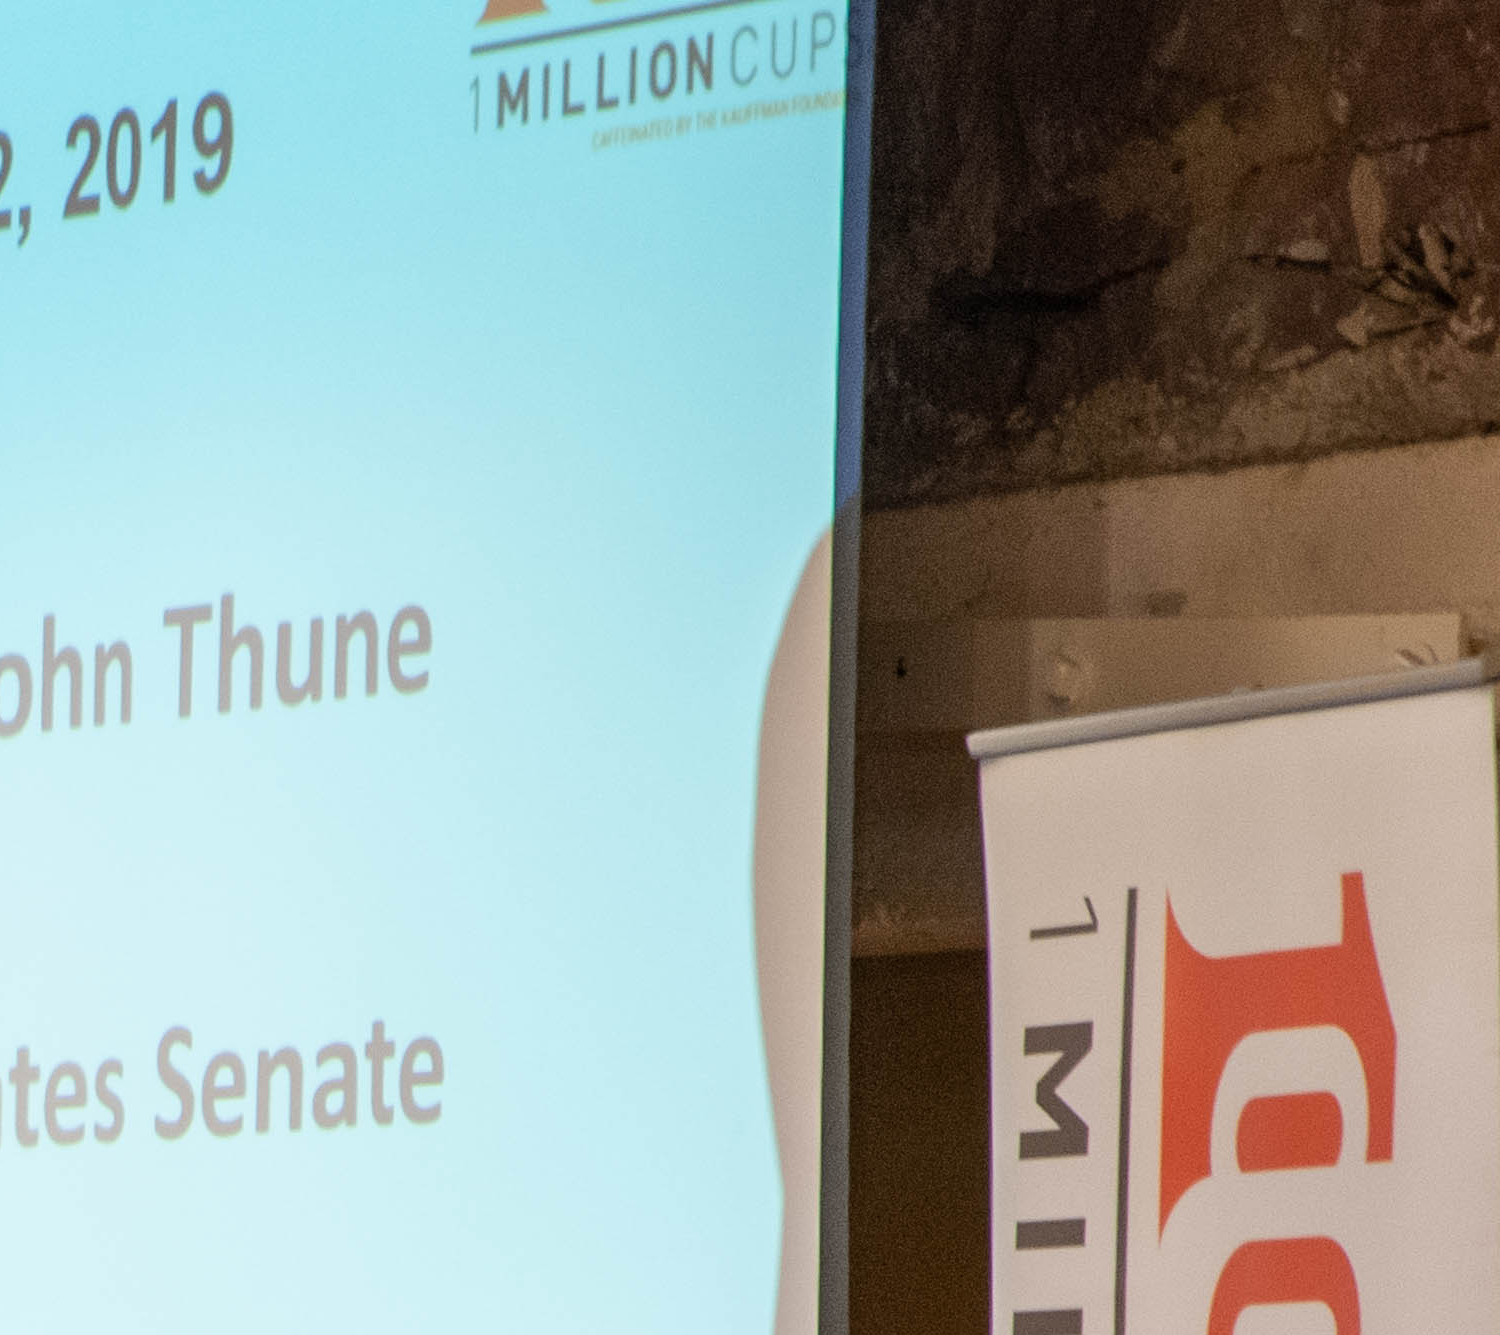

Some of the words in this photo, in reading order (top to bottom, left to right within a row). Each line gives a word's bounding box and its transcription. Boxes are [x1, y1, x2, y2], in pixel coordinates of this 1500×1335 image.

[469, 74, 481, 134] 1
[496, 32, 715, 131] MILLION
[62, 89, 235, 221] 2019
[162, 592, 434, 723] Thune
[1028, 893, 1100, 942] 1
[153, 1016, 448, 1145] Senate
